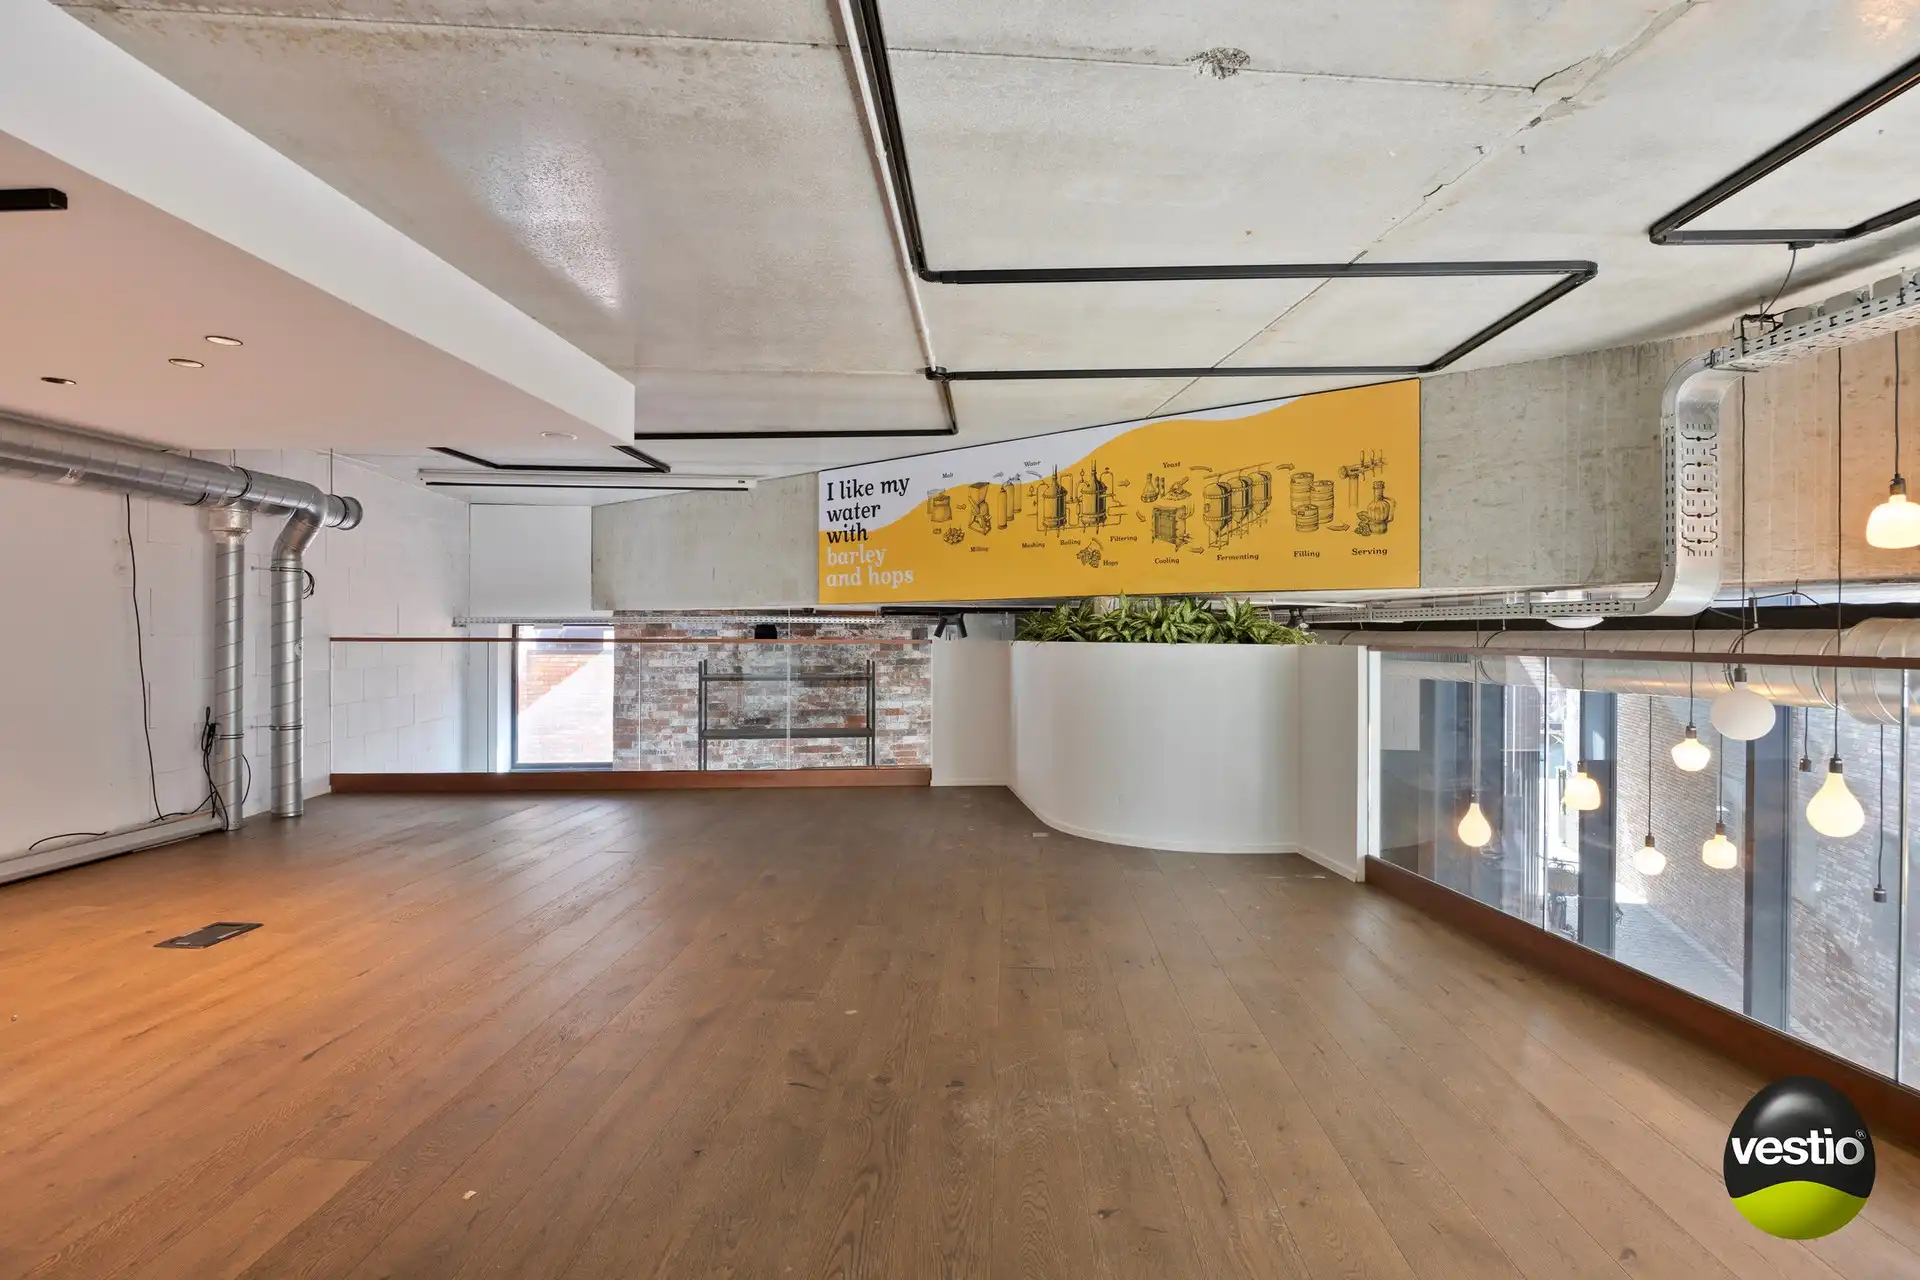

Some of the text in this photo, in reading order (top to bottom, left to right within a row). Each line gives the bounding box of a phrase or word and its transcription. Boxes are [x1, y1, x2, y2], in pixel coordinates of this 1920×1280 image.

[1162, 461, 1181, 469] Yeast
[827, 478, 910, 501] I like my
[826, 502, 881, 522] water
[826, 522, 868, 544] with
[827, 544, 887, 567] barley
[1216, 553, 1259, 561] Fermenting
[1293, 550, 1320, 558] Filling
[1351, 547, 1388, 556] Serving
[1154, 557, 1180, 565] Cooling
[826, 565, 914, 589] and hops
